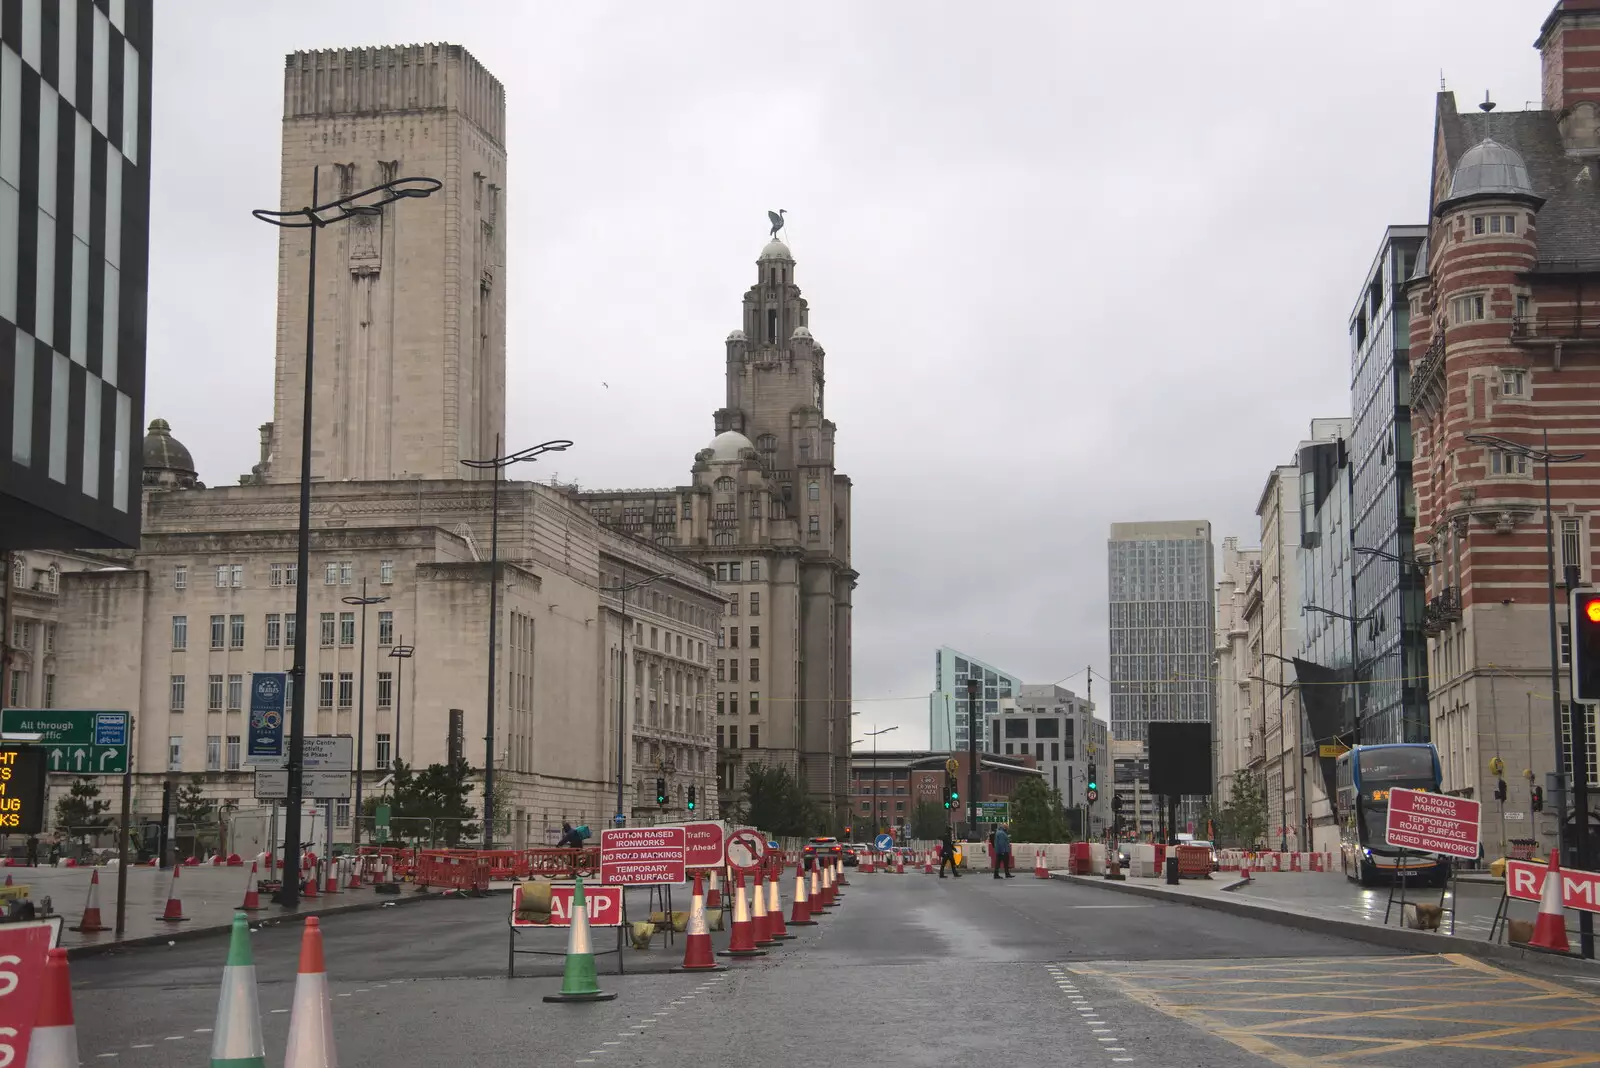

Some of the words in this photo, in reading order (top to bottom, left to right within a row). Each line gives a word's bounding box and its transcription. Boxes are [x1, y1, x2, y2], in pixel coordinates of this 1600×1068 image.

[20, 720, 34, 730] All
[36, 720, 74, 731] through
[1414, 795, 1428, 804] NO
[1430, 798, 1456, 808] ROAD
[1412, 803, 1457, 817] MARKINGS
[1408, 815, 1460, 830] TEMPORARY
[686, 831, 711, 839] Traffic
[1399, 821, 1425, 831] ROAD
[1427, 826, 1467, 839] SURFACE
[607, 832, 644, 840] CAUTION
[616, 839, 665, 847] IRONWORKS
[1389, 833, 1420, 844] RAISED
[1422, 839, 1475, 854] IRONWORKS
[602, 853, 614, 861] NO
[616, 852, 638, 860] ROAD
[640, 851, 683, 859] MARKINGS
[616, 864, 668, 873] TEMPORARY
[635, 873, 675, 881] SURFACE
